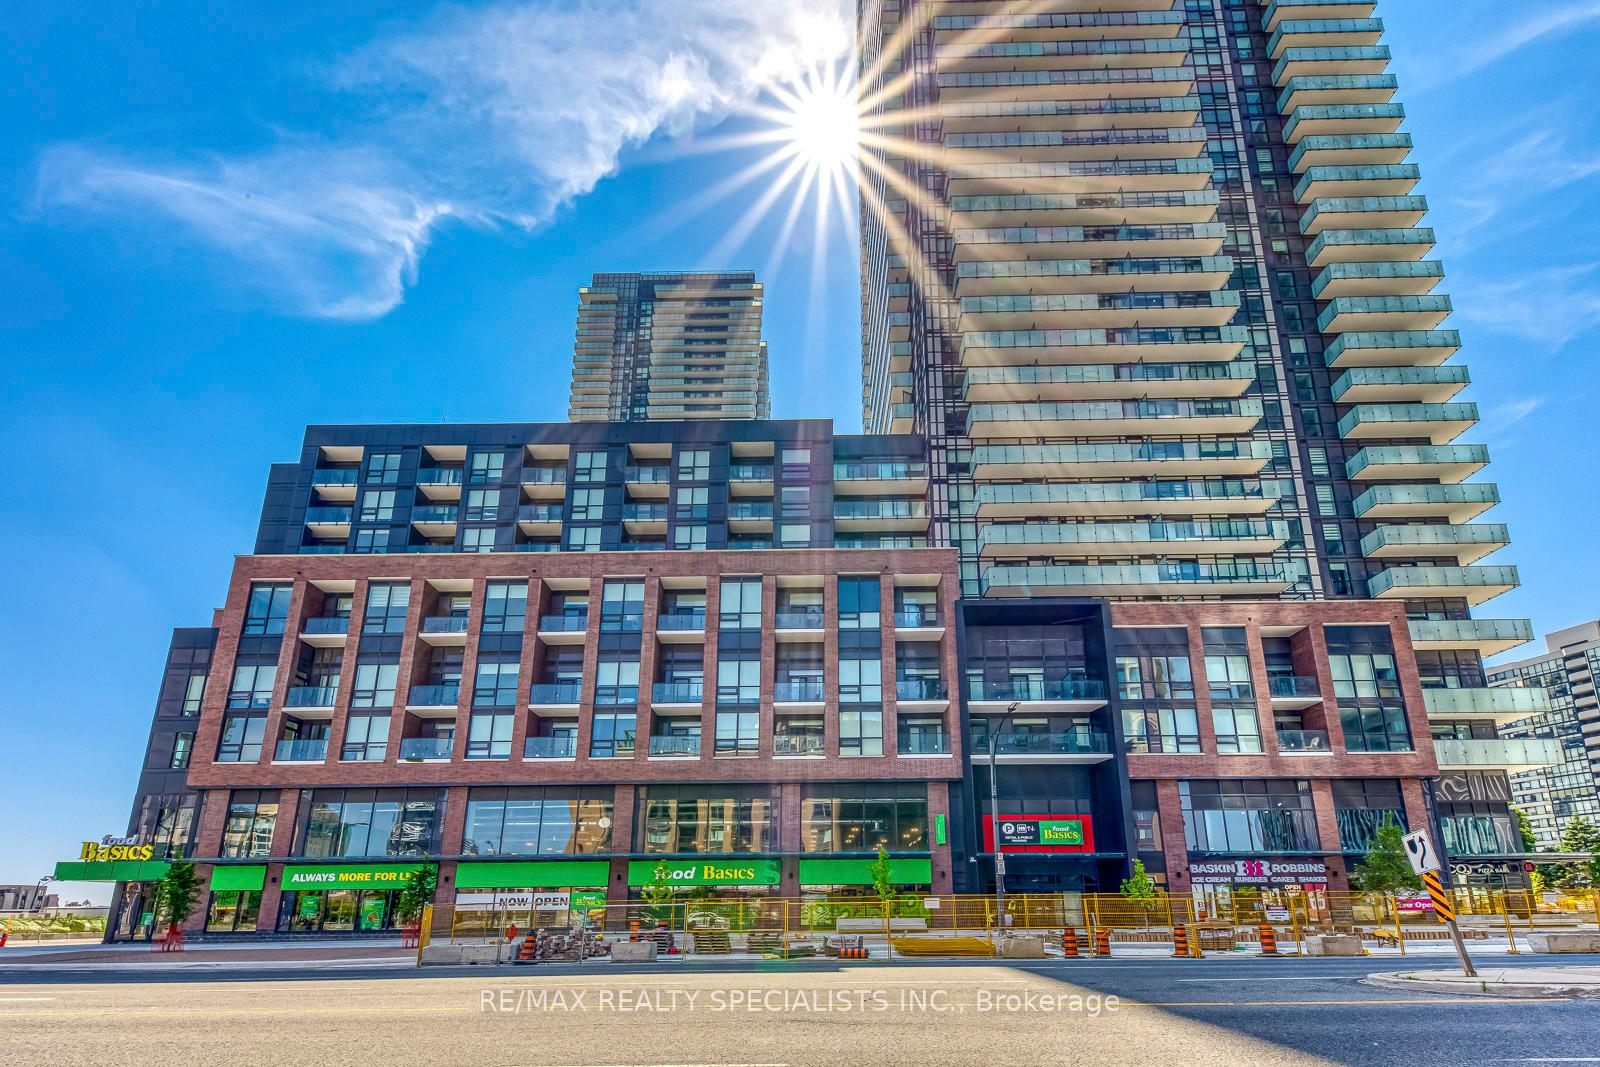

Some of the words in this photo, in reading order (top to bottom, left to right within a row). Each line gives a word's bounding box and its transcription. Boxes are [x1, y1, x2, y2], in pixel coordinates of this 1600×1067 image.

[102, 834, 139, 846] food
[1044, 829, 1079, 840] Basics
[79, 841, 153, 862] Basics
[703, 866, 754, 880] Basics
[1190, 864, 1235, 873] BASKIN
[1272, 864, 1326, 873] ROBBINS
[292, 873, 335, 882] ALWAYS
[339, 873, 371, 881] MORE
[375, 872, 396, 880] FOR
[499, 898, 529, 906] NOW
[535, 897, 569, 906] OPEN
